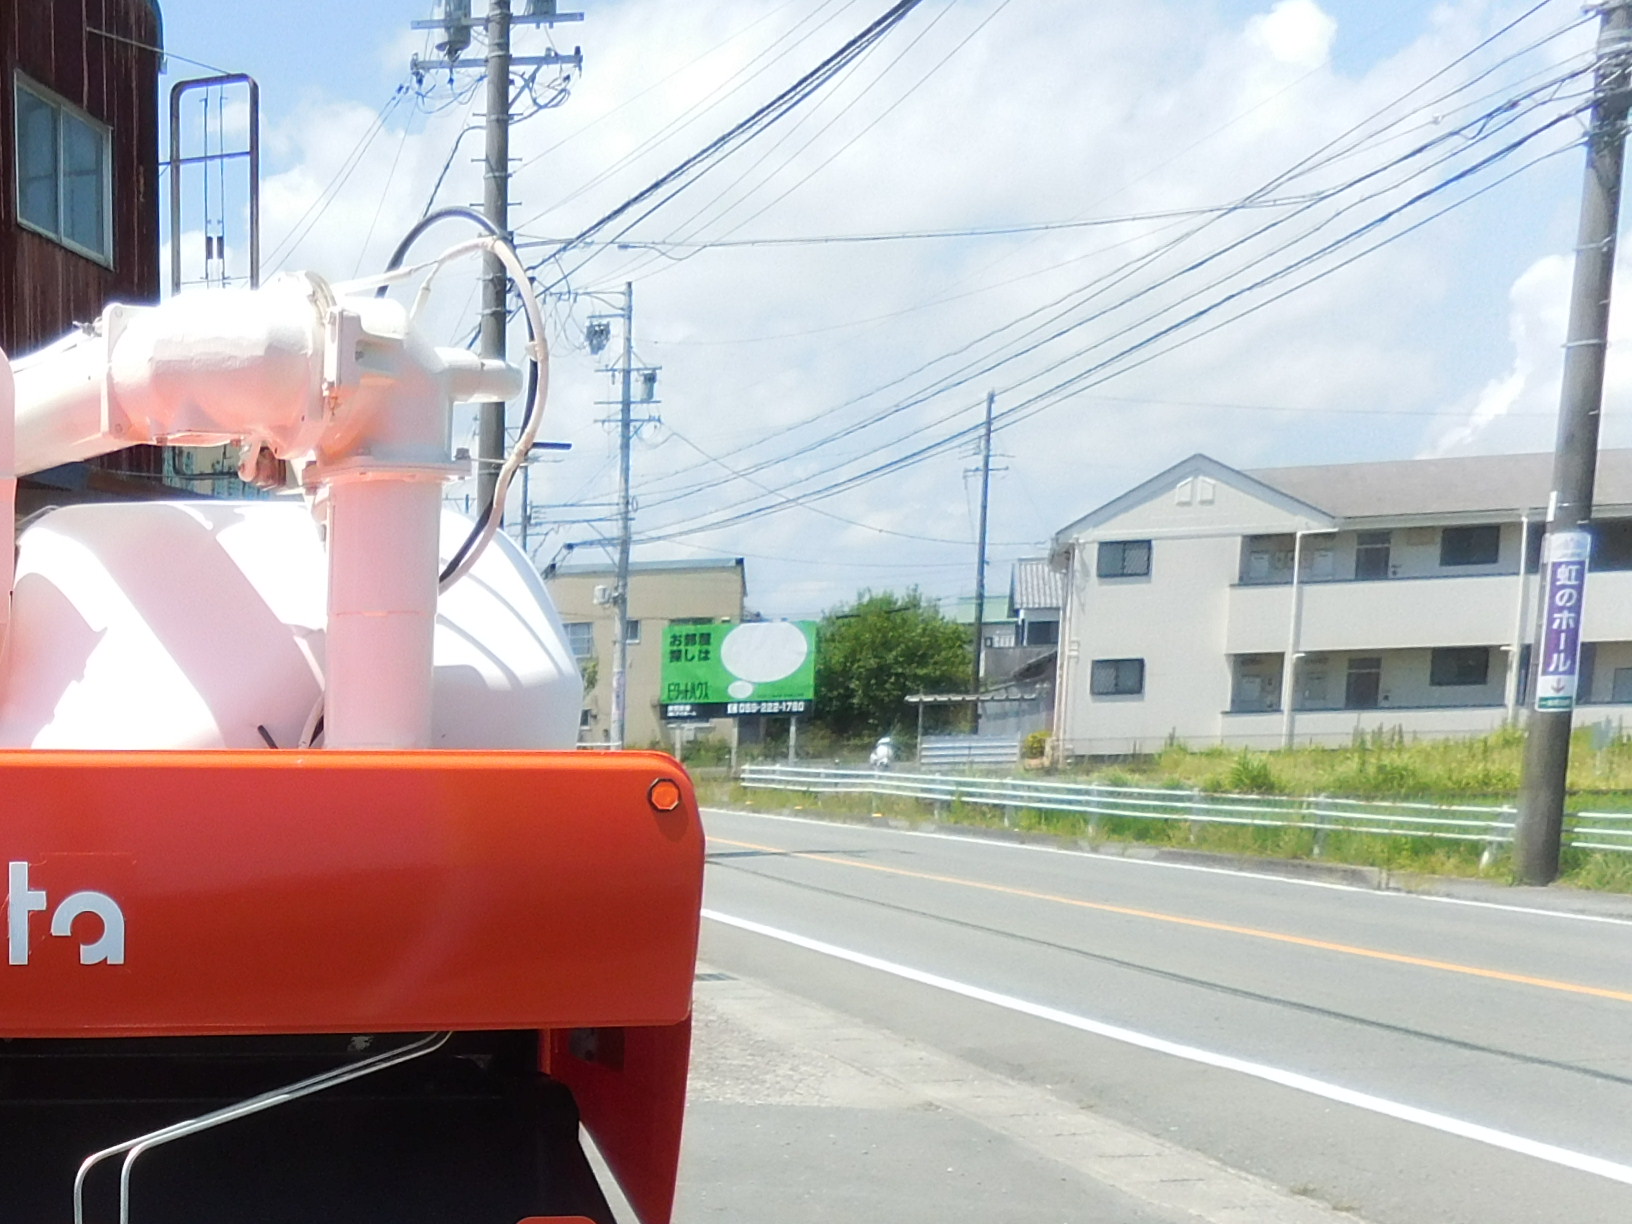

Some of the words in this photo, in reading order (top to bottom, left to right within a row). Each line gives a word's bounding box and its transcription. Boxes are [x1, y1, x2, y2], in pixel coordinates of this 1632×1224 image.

[1548, 563, 1581, 673] 虹のホール
